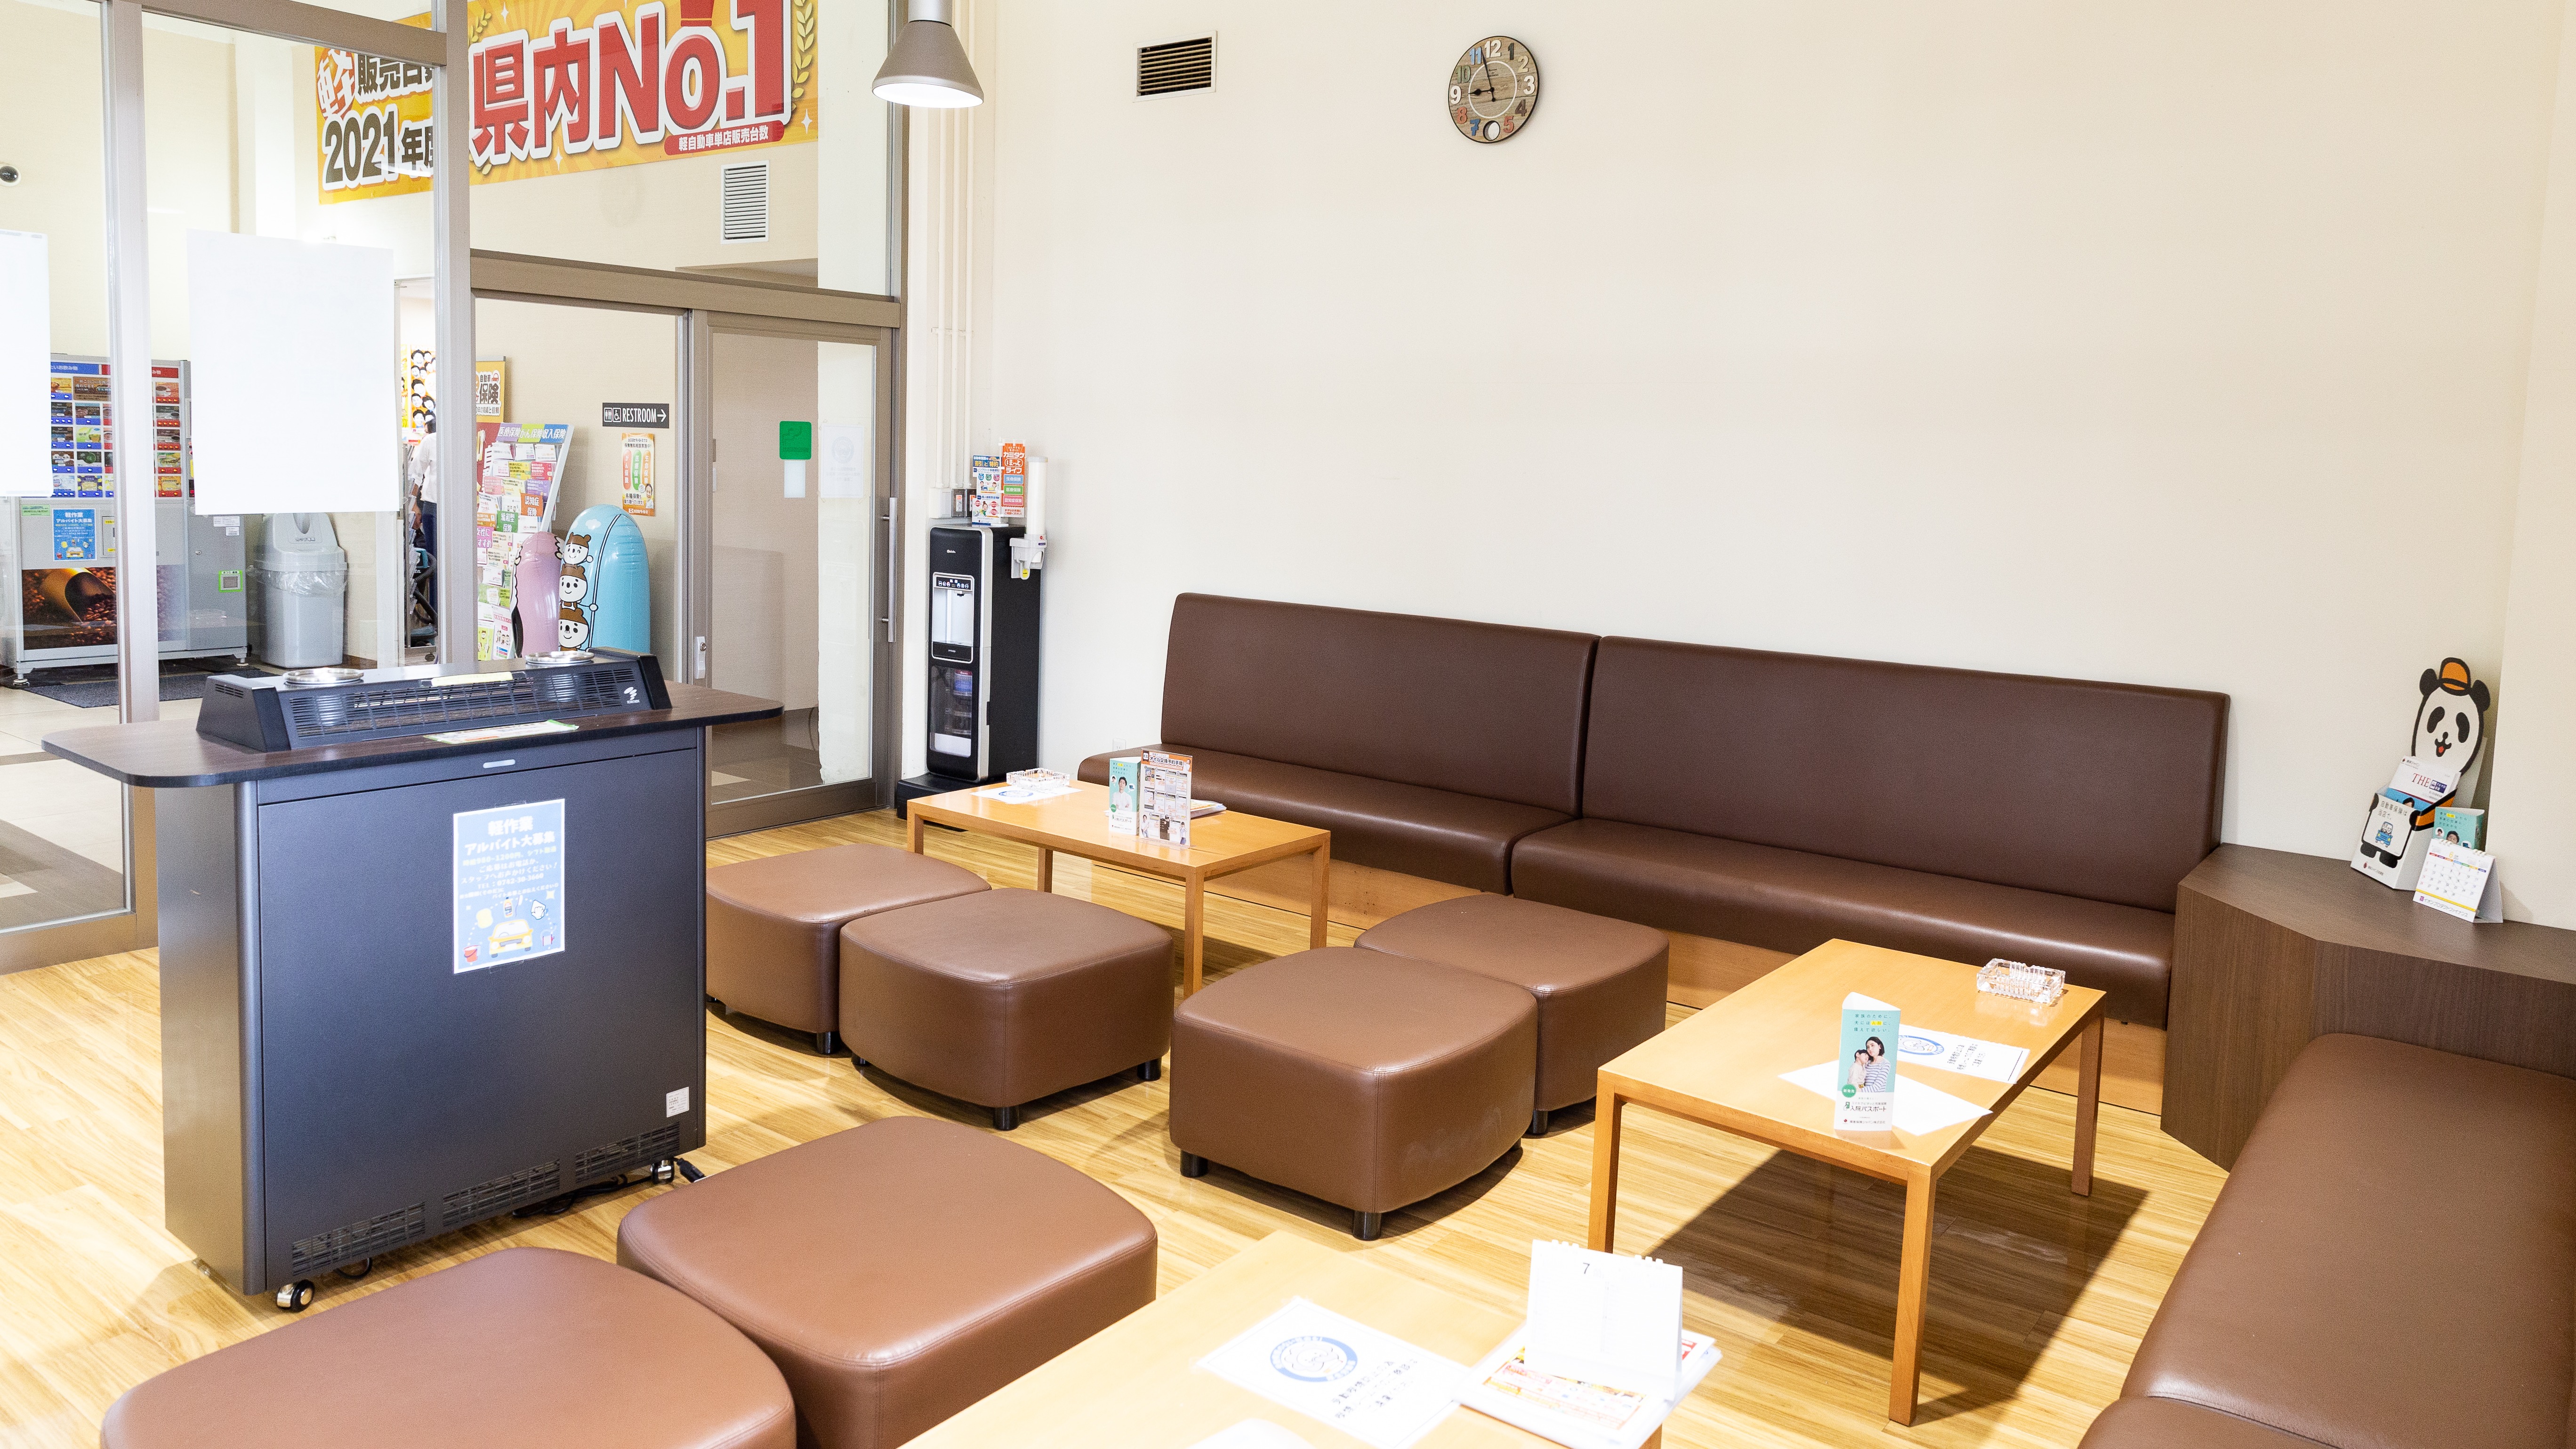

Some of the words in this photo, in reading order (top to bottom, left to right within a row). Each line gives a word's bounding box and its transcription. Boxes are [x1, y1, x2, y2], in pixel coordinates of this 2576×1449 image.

[1469, 47, 1482, 65] 11
[1484, 40, 1501, 58] 12
[1508, 43, 1514, 60] 1
[1517, 55, 1529, 73] 2
[1455, 65, 1471, 83] 10
[1523, 75, 1535, 95] 3
[1450, 86, 1461, 104] 9
[1457, 106, 1467, 124] 8
[1515, 99, 1527, 116] 4
[1470, 119, 1481, 136] 7
[1503, 116, 1514, 133] 5
[678, 125, 769, 152] 軽自動車単店販売台数
[480, 383, 499, 404] 保険
[622, 408, 657, 423] RESTROOM
[498, 427, 521, 438] 医療保険
[519, 428, 542, 439] がん保険
[541, 428, 566, 440] 収入保険
[524, 496, 539, 507] 認知症
[2411, 773, 2431, 788] THE
[488, 815, 533, 837] 軽作業
[464, 830, 555, 856] アルバイト大募集
[1582, 1262, 1590, 1274] 7
